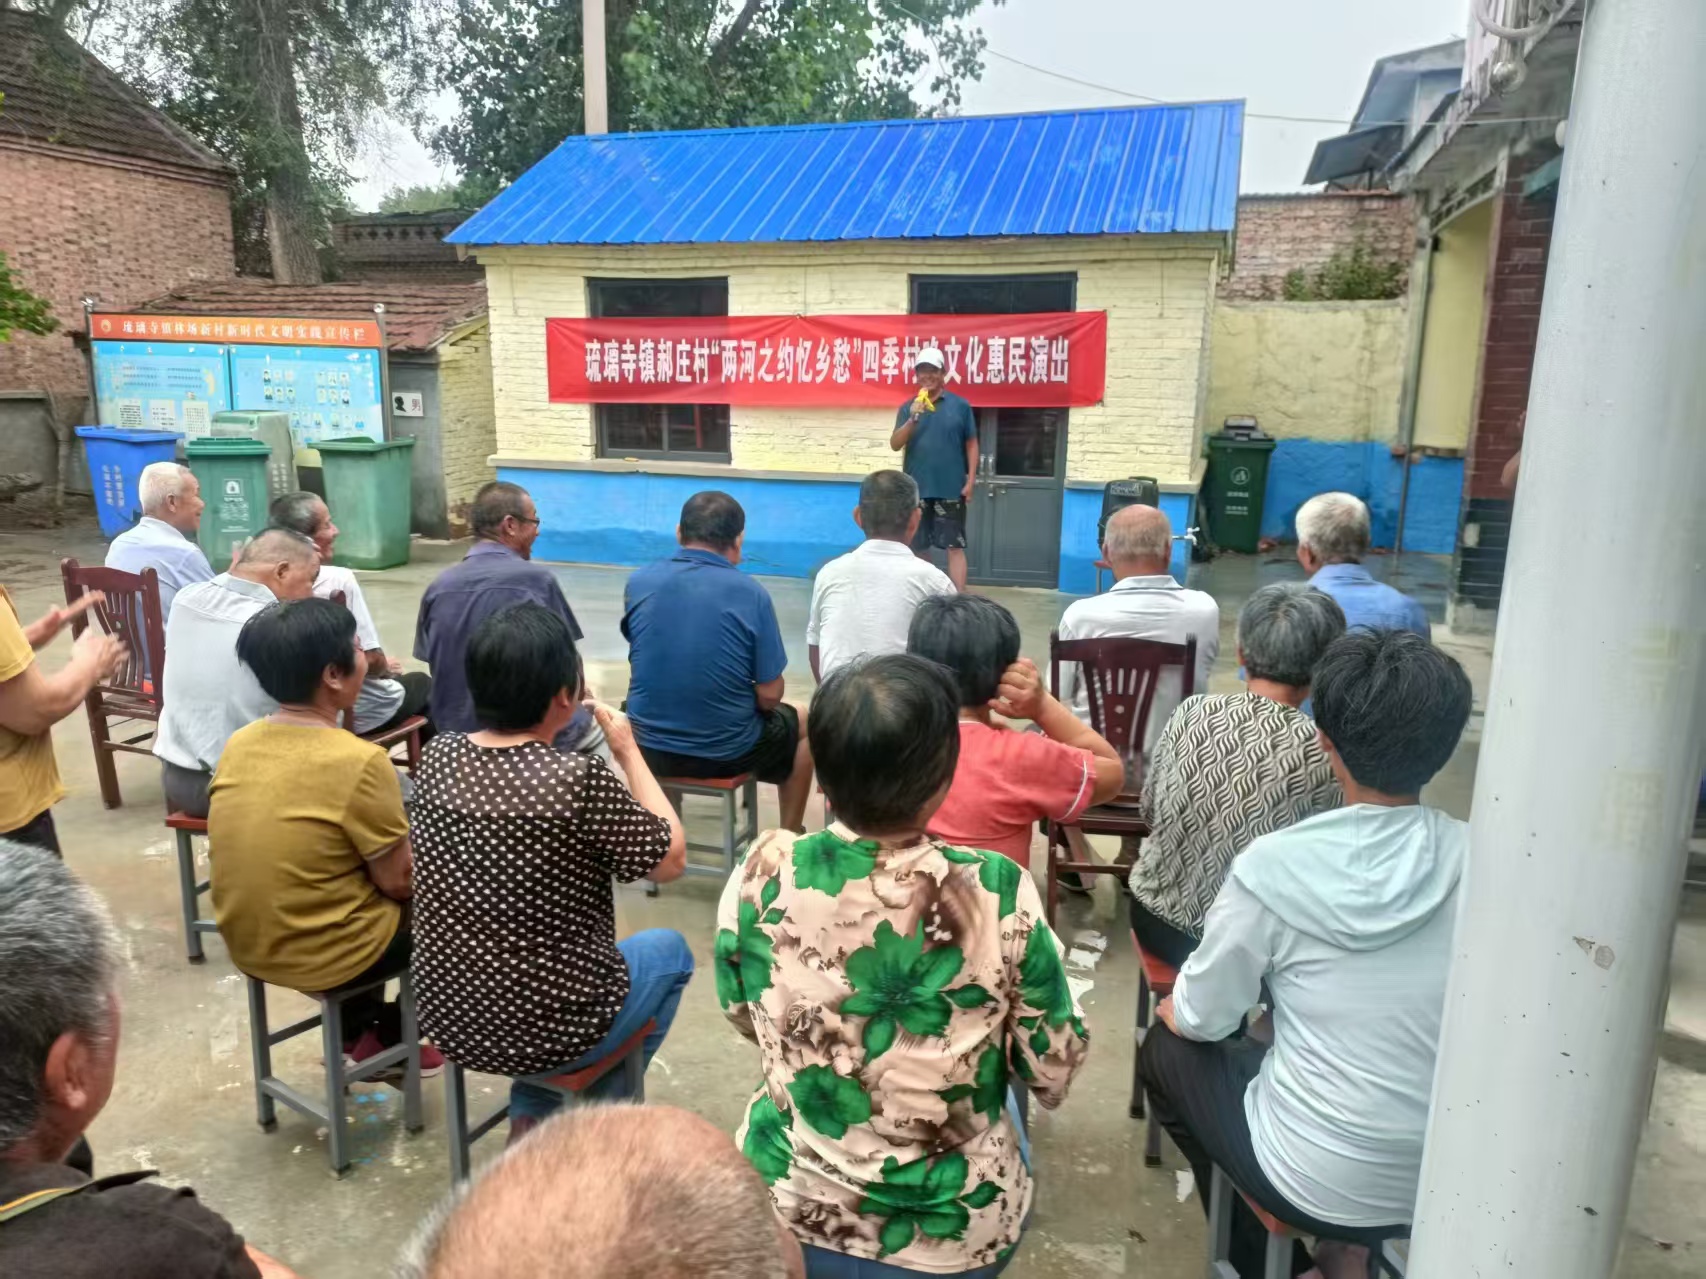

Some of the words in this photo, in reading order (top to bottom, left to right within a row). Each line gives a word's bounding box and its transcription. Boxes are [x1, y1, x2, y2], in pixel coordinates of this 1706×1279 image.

[585, 336, 1069, 384] 琉璃寺镇郝庄村“两河之约忆乡愁”四季村文化惠民演出
[412, 399, 421, 411] 男
